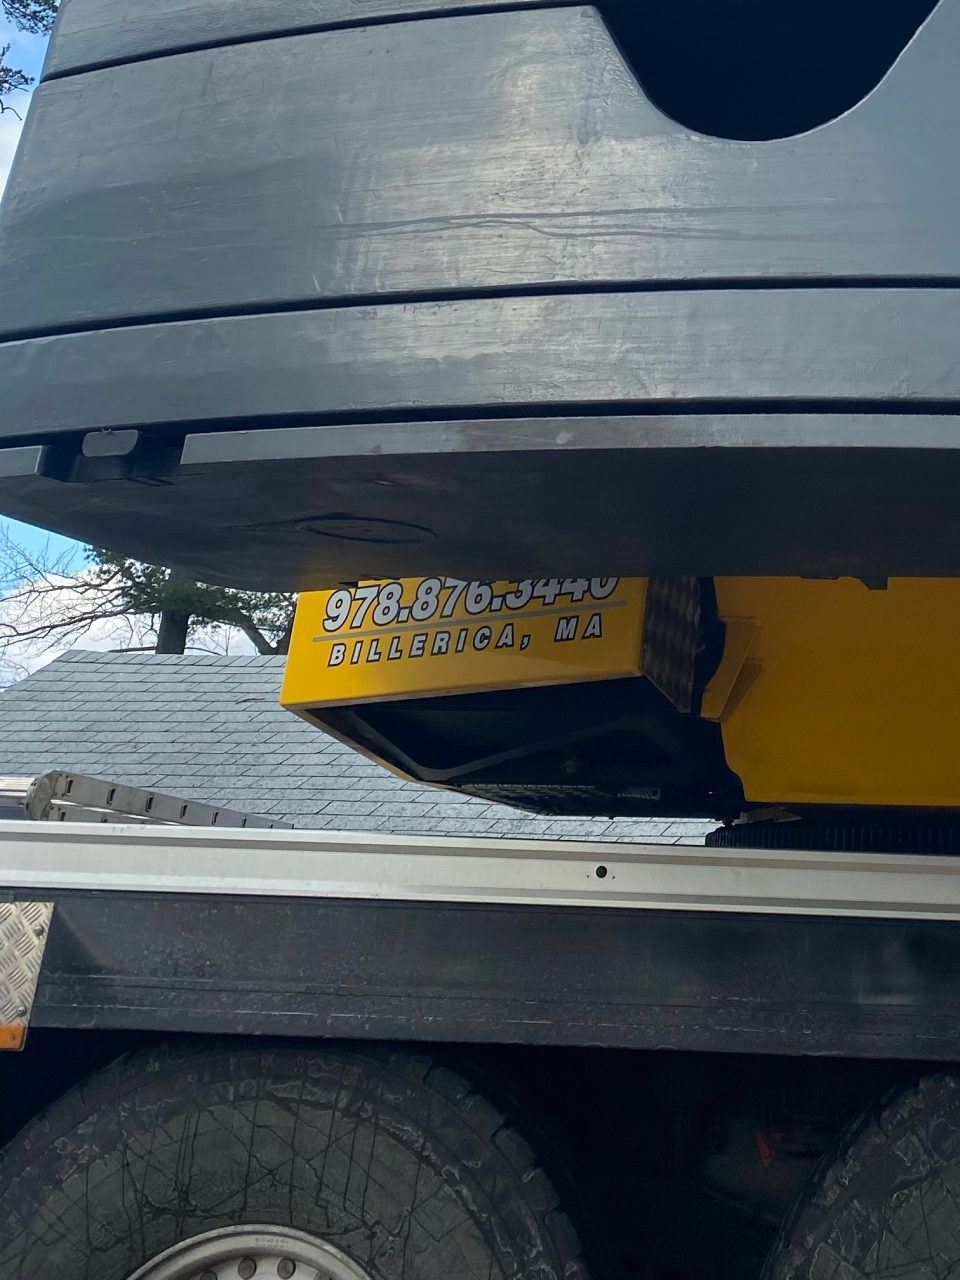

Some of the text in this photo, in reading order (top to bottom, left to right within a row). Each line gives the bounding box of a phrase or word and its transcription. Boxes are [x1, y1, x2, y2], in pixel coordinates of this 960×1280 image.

[322, 577, 620, 632] 978.876.3440
[327, 612, 603, 667] BILLERICA, MA
